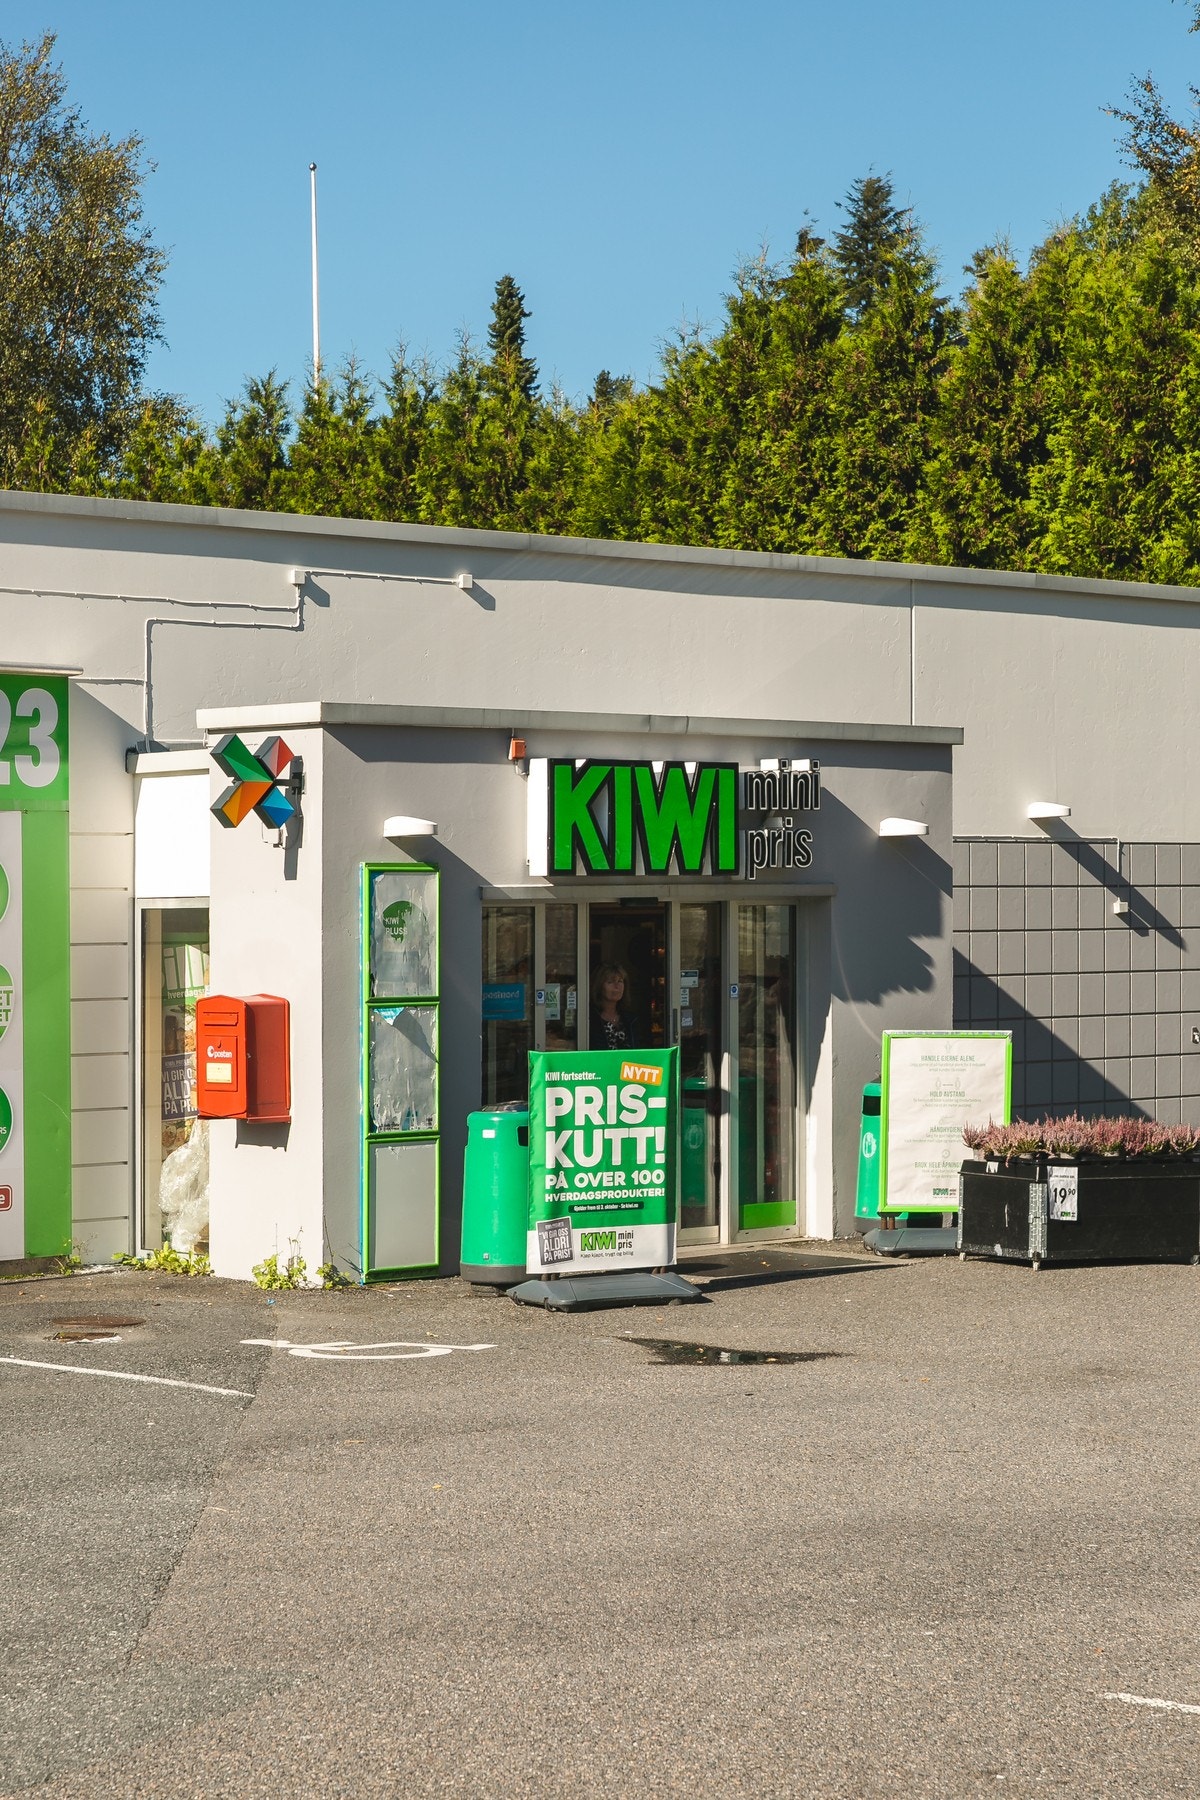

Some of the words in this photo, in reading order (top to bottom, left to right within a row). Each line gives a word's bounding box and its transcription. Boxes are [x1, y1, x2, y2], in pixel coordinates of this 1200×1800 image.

[0, 688, 60, 788] 3
[550, 760, 739, 875] KIWI
[748, 759, 821, 811] mini
[748, 817, 814, 880] pris
[545, 1071, 560, 1081] KIWI
[561, 1071, 601, 1080] fortsetter...
[623, 1065, 660, 1082] NYTT
[545, 1084, 667, 1127] PRIS-
[545, 1127, 666, 1169] KUTT!
[545, 1171, 568, 1190] PÅ
[574, 1172, 626, 1188] OVER
[631, 1169, 665, 1185] 100
[545, 1188, 665, 1202] HVERDAGSPRODUKTER!
[558, 1227, 569, 1236] OSS
[580, 1231, 617, 1251] KIWI
[618, 1230, 634, 1240] mini
[544, 1235, 570, 1253] ALDRI
[618, 1240, 633, 1251] pris
